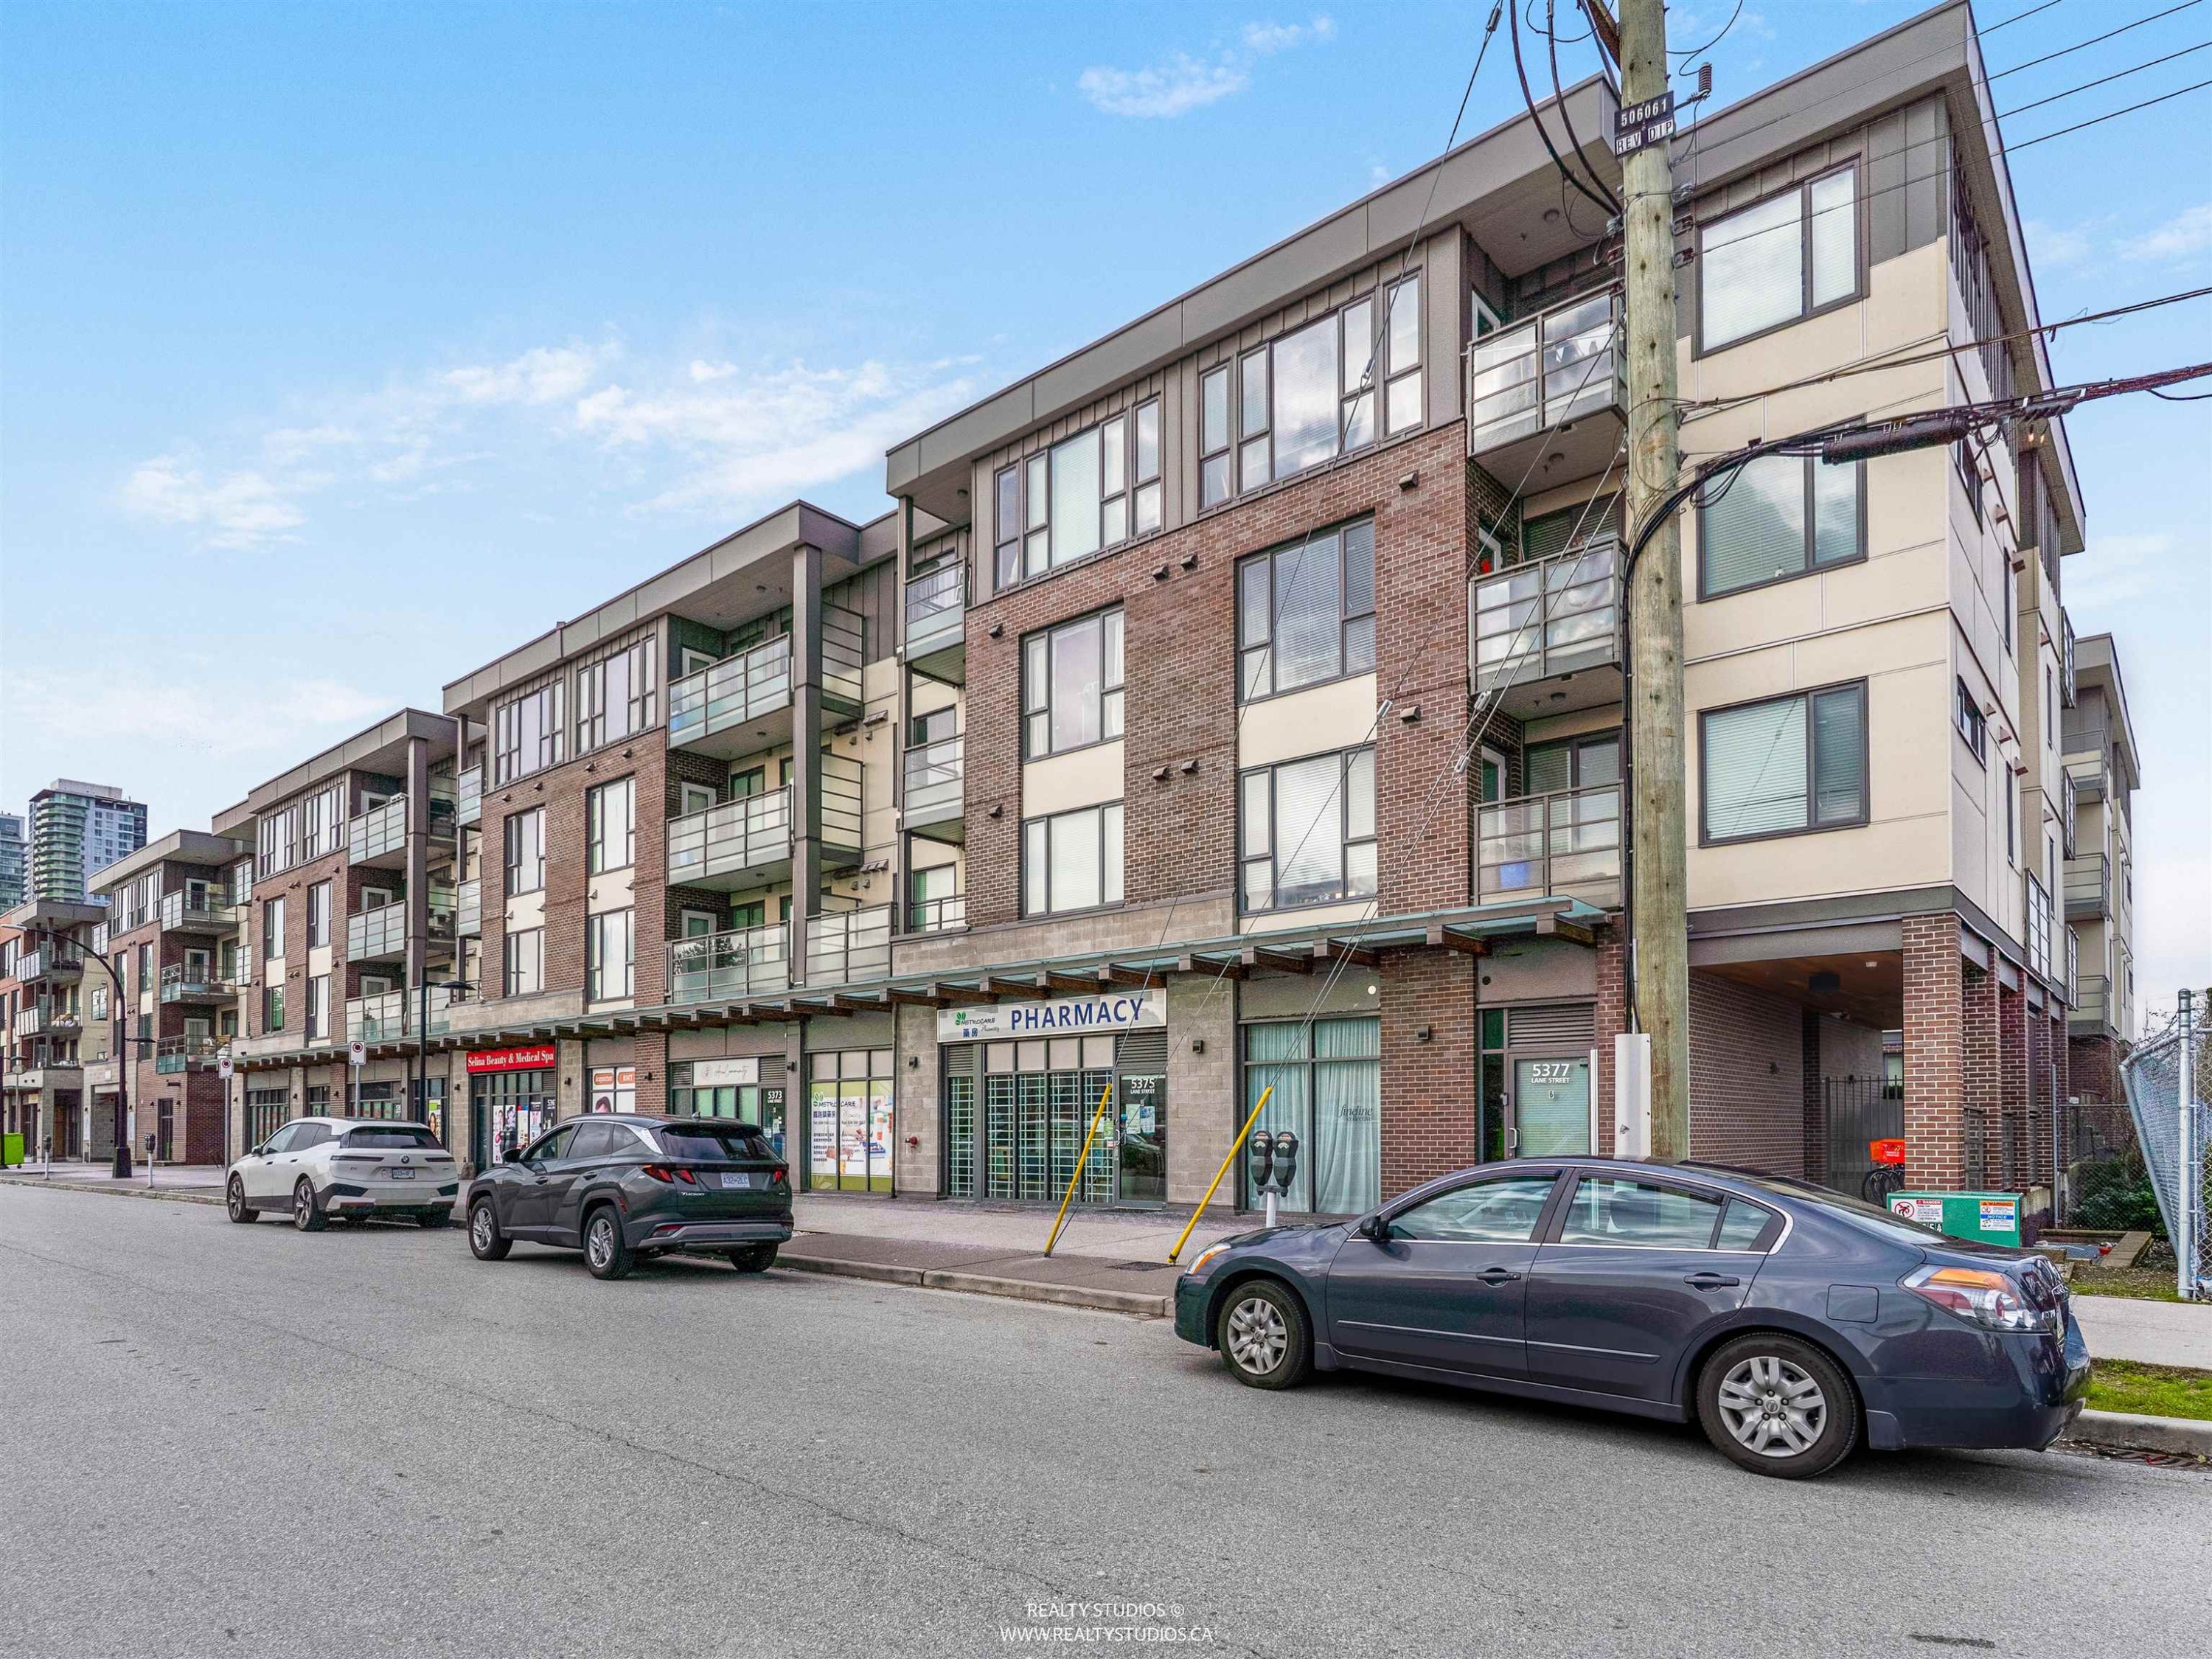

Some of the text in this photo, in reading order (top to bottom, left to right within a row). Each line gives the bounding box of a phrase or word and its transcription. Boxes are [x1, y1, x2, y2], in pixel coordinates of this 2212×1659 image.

[1621, 97, 1666, 127] 506061
[1618, 121, 1672, 153] REV DIP
[961, 1018, 995, 1026] METROCARE
[1011, 998, 1144, 1031] PHARMACY
[467, 1051, 554, 1067] Selina Beauty & Medical Spa
[1533, 1063, 1570, 1077] 5377
[1131, 1078, 1155, 1089] 5375
[768, 1091, 782, 1099] 5373
